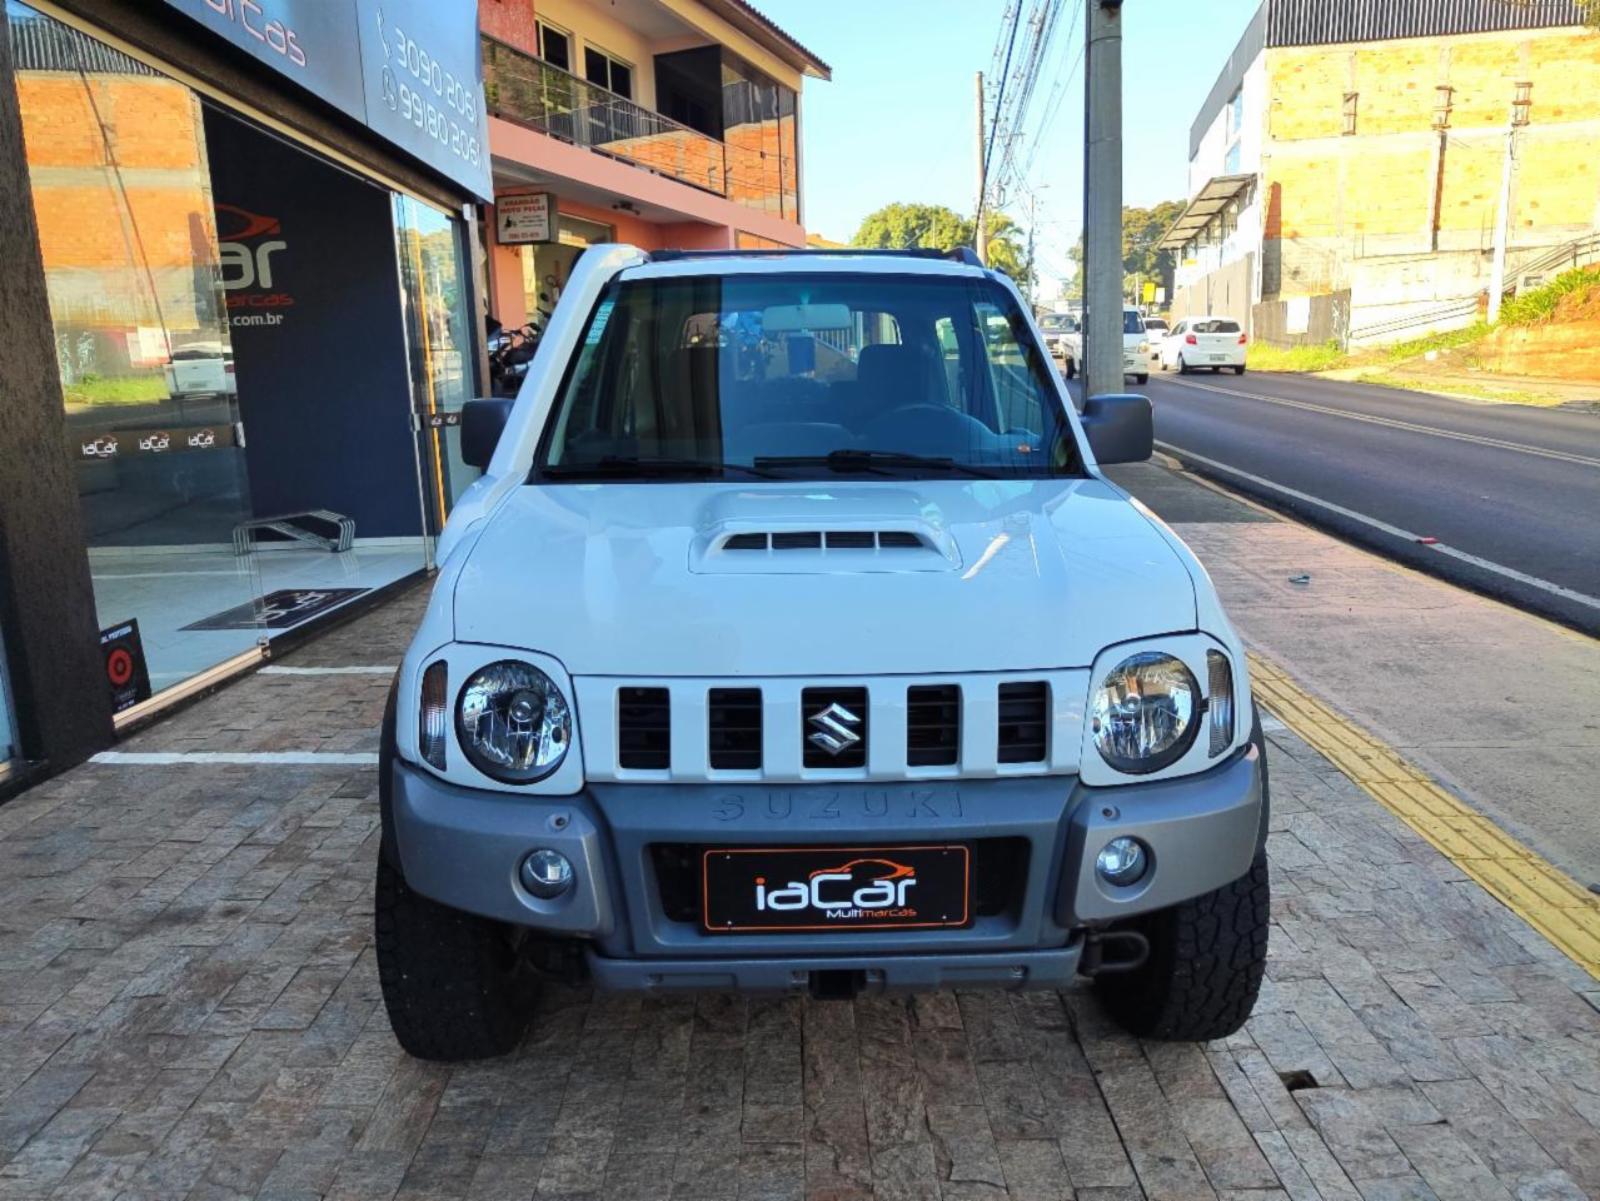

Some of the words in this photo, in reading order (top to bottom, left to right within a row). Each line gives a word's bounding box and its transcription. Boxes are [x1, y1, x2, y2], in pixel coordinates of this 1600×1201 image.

[395, 27, 443, 97] 3090
[400, 83, 449, 146] 99180
[711, 789, 964, 822] SUZUKI
[755, 873, 917, 911] iaCar
[826, 907, 918, 919] Multimarcas
